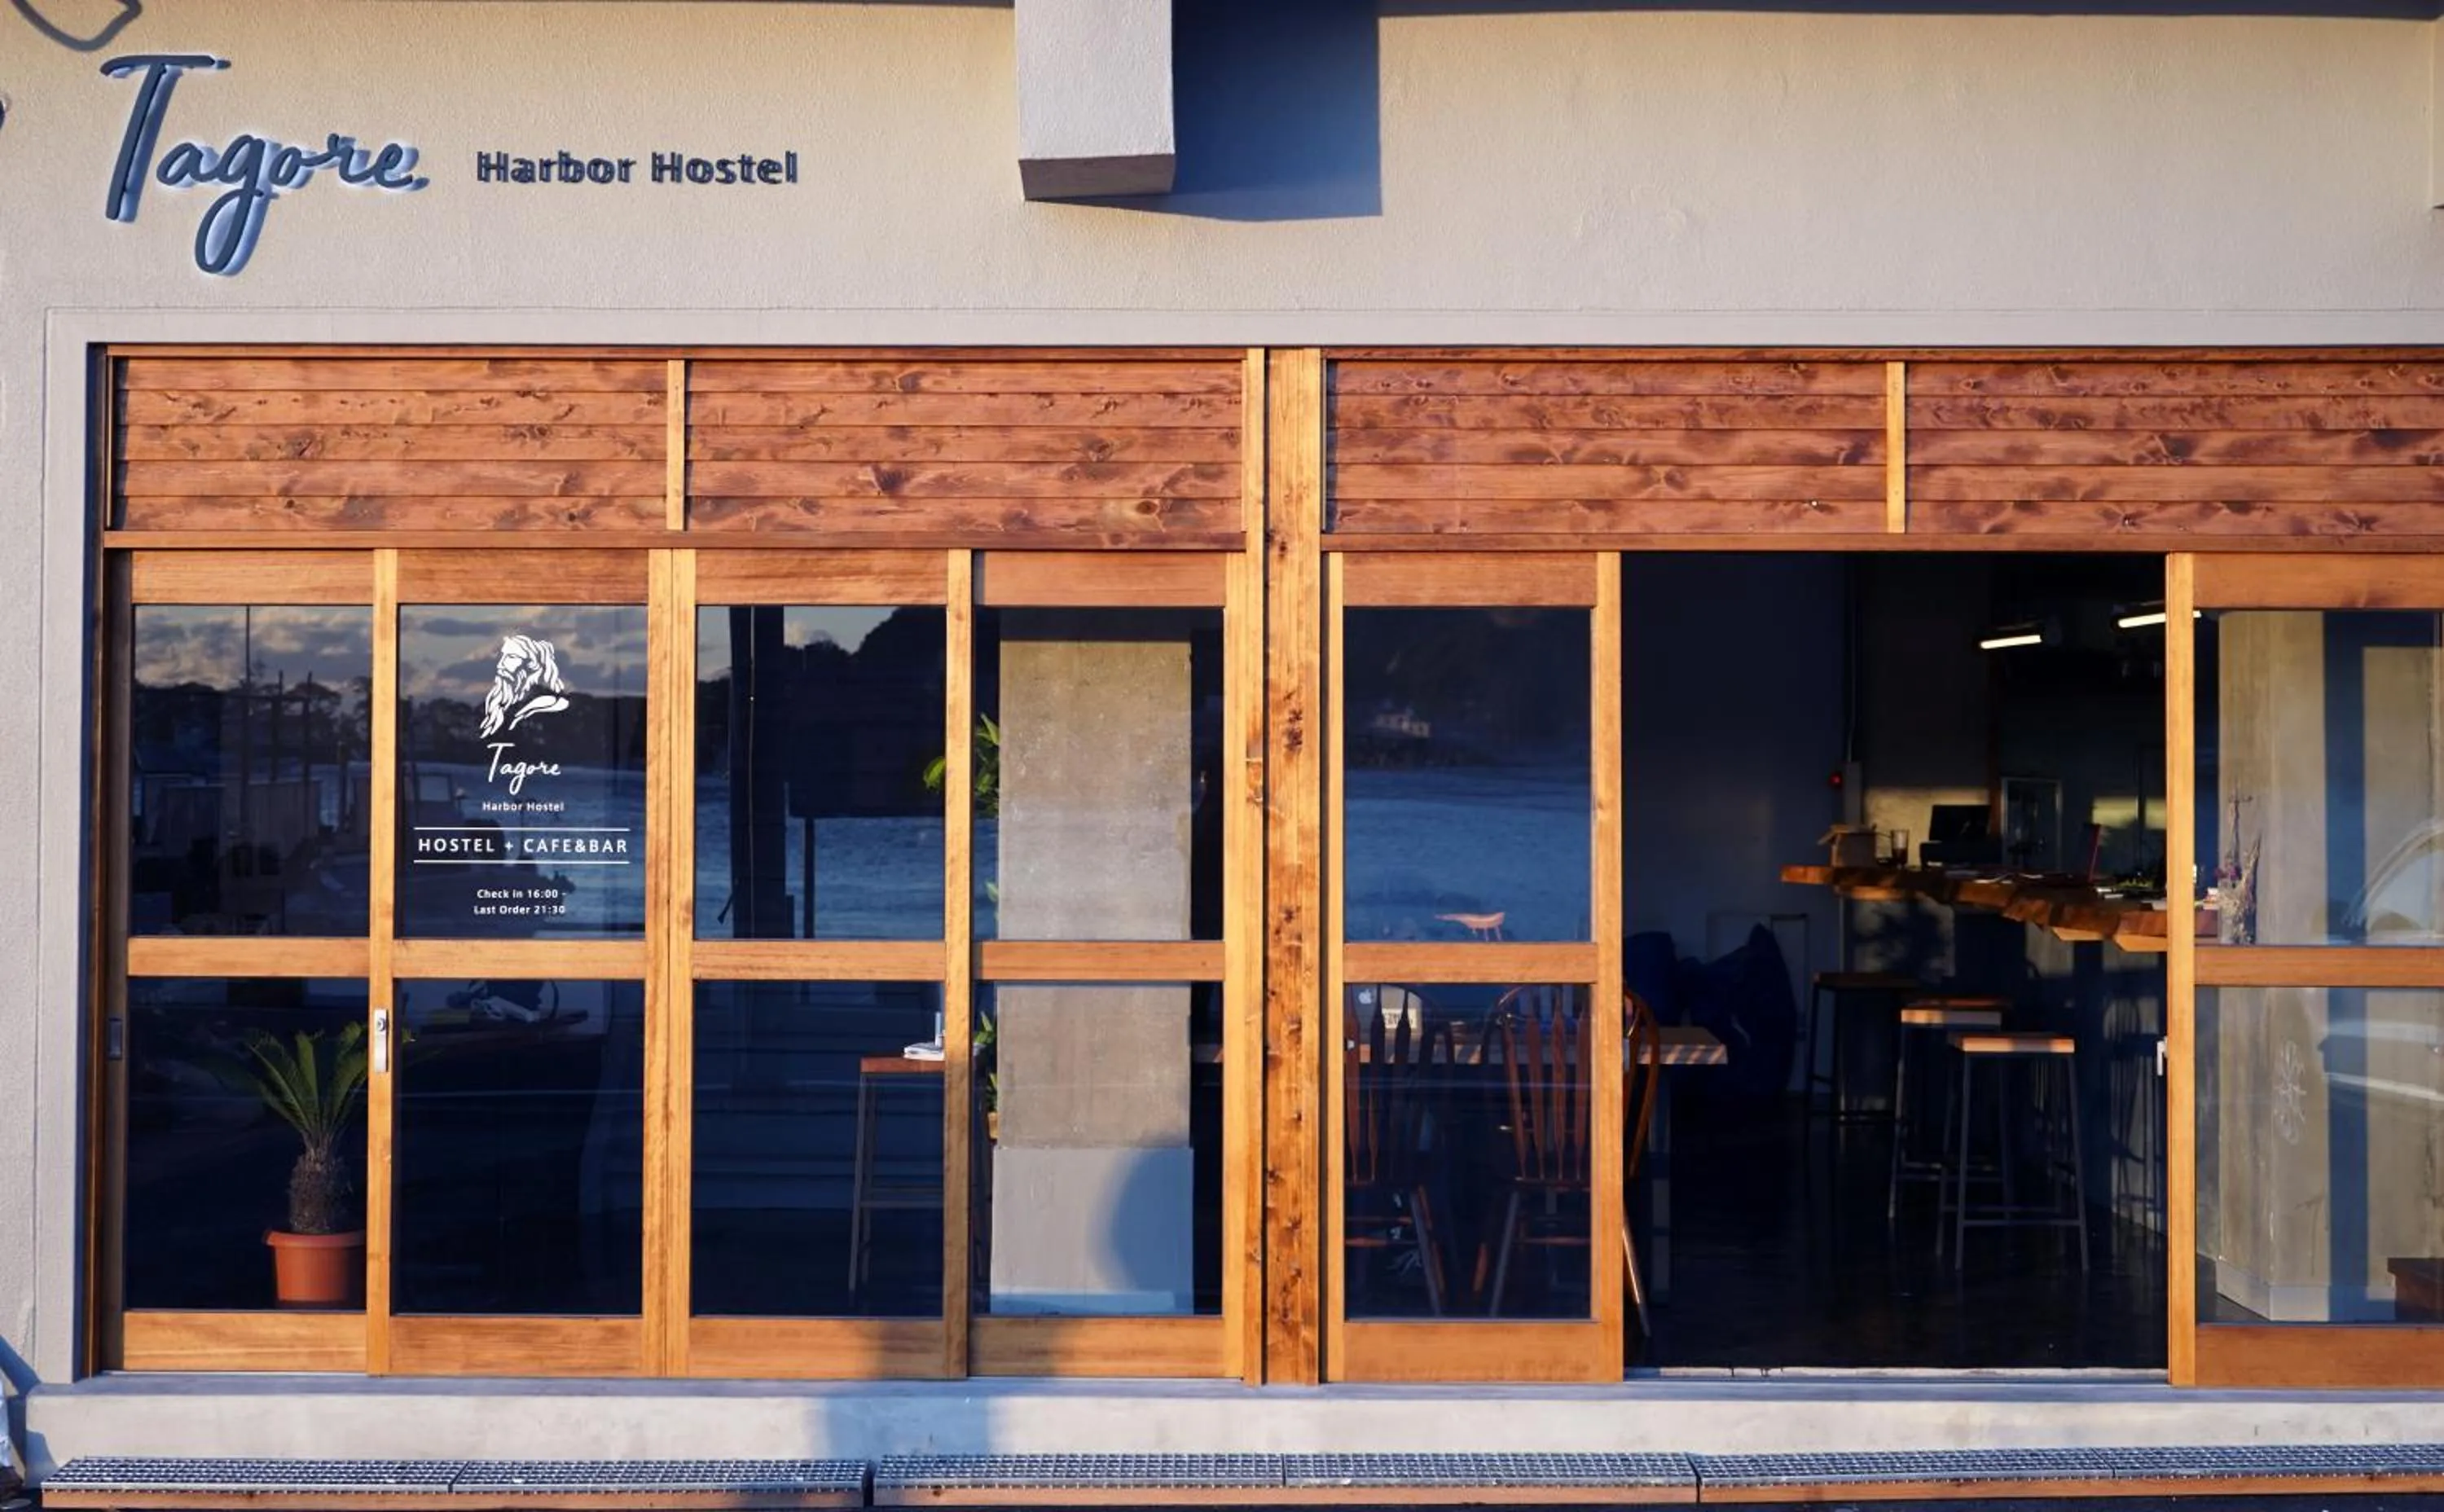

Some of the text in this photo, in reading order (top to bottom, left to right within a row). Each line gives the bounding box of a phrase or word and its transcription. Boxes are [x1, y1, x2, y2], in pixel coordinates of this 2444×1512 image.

[99, 54, 427, 275] Tagore
[477, 150, 798, 184] Harbor Hostel
[486, 742, 561, 796] Tagore
[481, 801, 565, 812] Harbor Hostel
[418, 838, 495, 853] HOSTEL
[523, 838, 627, 853] CAFE&BAR
[477, 889, 509, 899] Check
[527, 889, 558, 899] 16:00
[473, 905, 566, 915] Last Order 21:30
